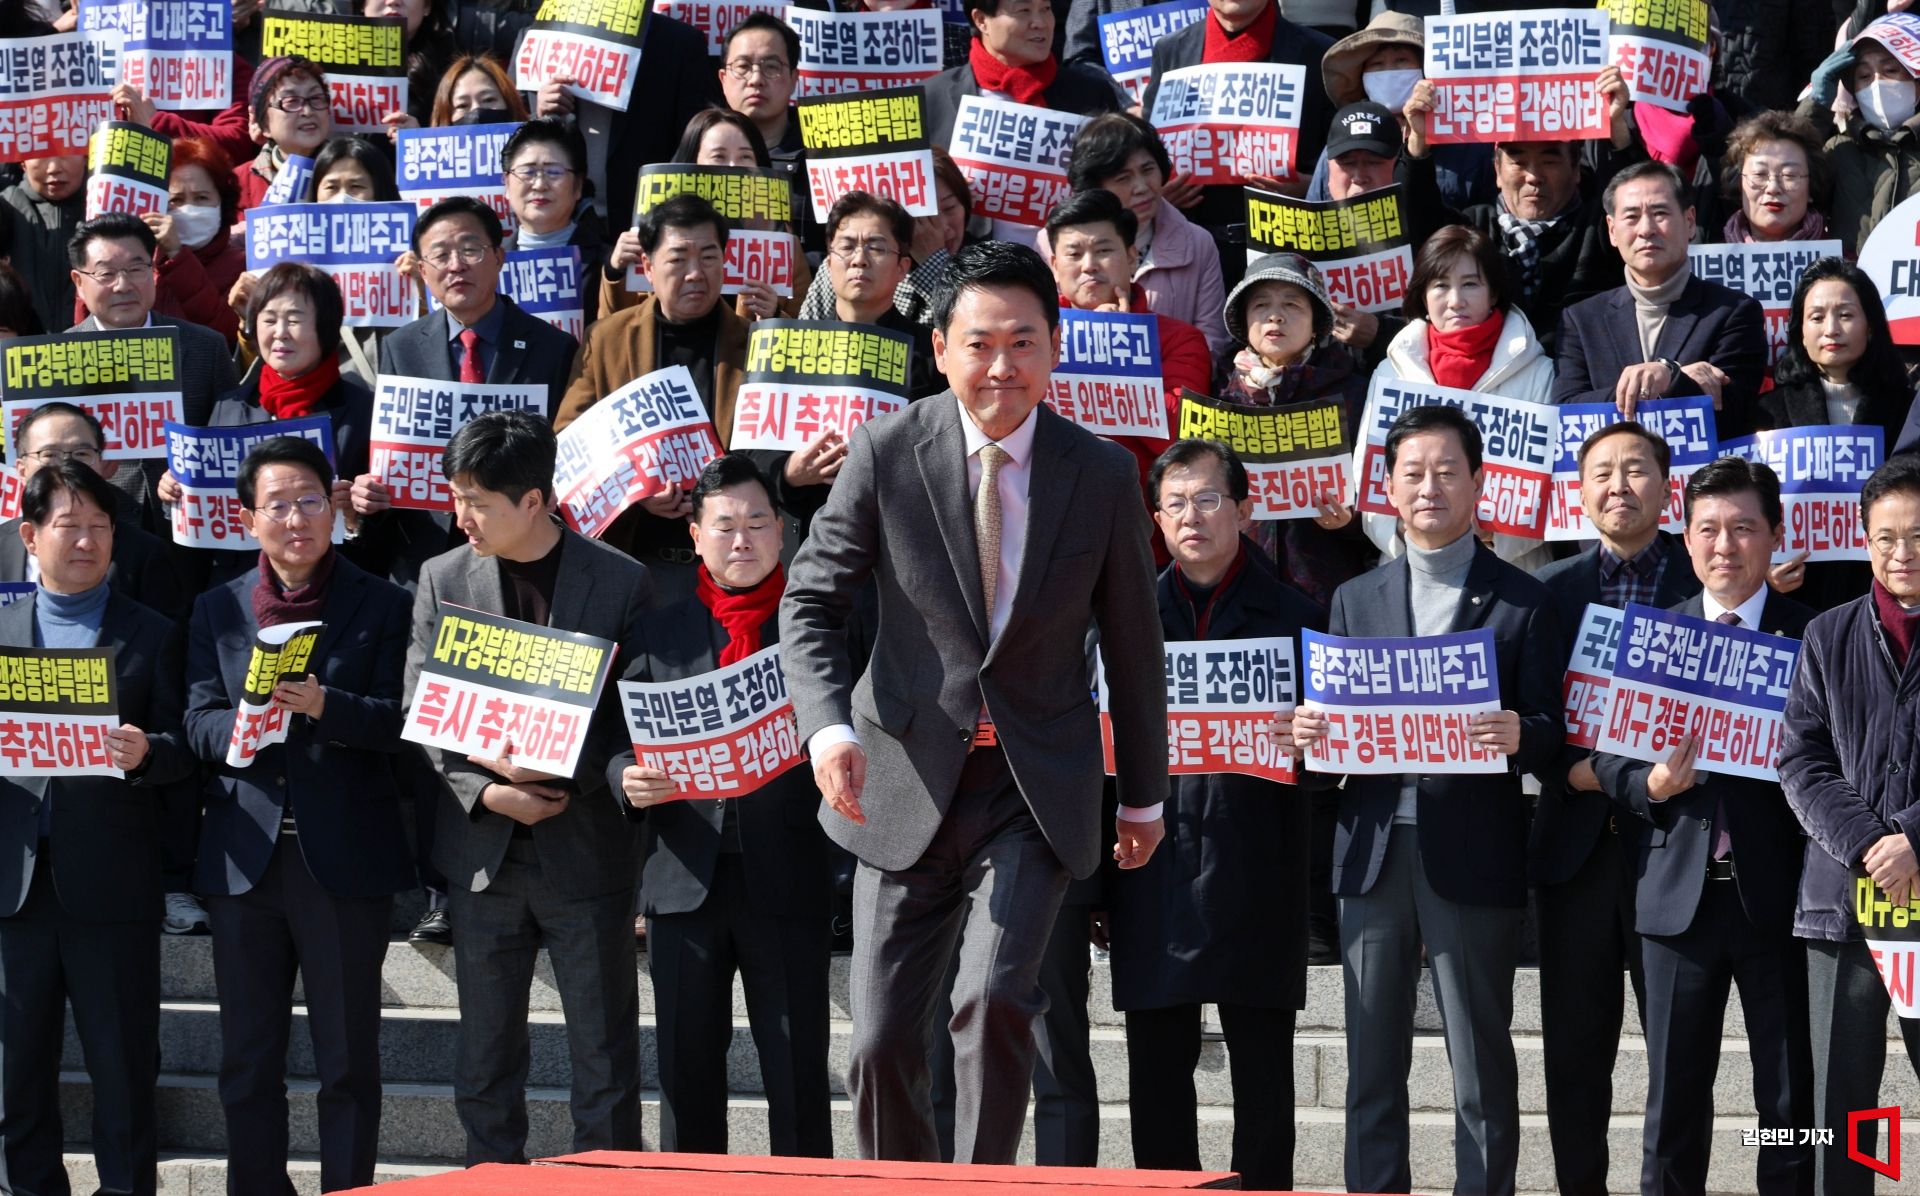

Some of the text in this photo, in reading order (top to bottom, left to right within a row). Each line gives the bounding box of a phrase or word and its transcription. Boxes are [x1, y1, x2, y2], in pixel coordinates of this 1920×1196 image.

[151, 2, 224, 41] 다퍼주고
[263, 17, 401, 66] 대구경북행정통합특별법
[863, 19, 937, 66] 조장하는
[1432, 19, 1603, 70] 국민분열 조장하는
[51, 41, 115, 88] 조장하는
[149, 57, 224, 100] 외면하나!
[519, 37, 548, 82] 즉시
[330, 82, 400, 126] 진하라
[1156, 74, 1217, 121] 국민분열
[1218, 73, 1295, 119] 조장하는
[1341, 112, 1381, 127] KOREA
[1434, 80, 1603, 136] 민주당은 각성하라
[403, 136, 471, 181] 광주전남
[959, 106, 1038, 162] 국민분열
[1216, 130, 1290, 178] 각성하라
[964, 166, 1026, 217] 주당은
[252, 212, 411, 259] 광주전남 다퍼주고
[1248, 195, 1402, 251] 대구경북행정통합특별법
[500, 257, 577, 304] 다퍼주고
[722, 238, 793, 287] 진하라
[1316, 255, 1408, 311] 진하라
[342, 270, 416, 317] 면하나!
[6, 337, 174, 389] 대구경북행정통합특별법
[748, 328, 908, 384] 대구경북행정통합특별법
[1073, 319, 1152, 367] 다퍼주고
[90, 400, 177, 451] 진하라
[378, 386, 454, 439] 국민분열
[611, 379, 699, 437] 조장하는
[738, 391, 788, 441] 즉시
[1080, 380, 1160, 428] 외면하나!
[168, 430, 240, 479] 광주전남
[1792, 436, 1875, 482] 다퍼주고
[1476, 471, 1541, 529] 성하라
[433, 614, 604, 695] 대구경북행정통합특별법
[1205, 647, 1293, 705] 조장하는
[1309, 641, 1489, 696] 광주전남 다퍼주고
[1627, 616, 1707, 682] 광주전남
[1703, 636, 1796, 700] 다퍼주고
[416, 681, 581, 767] 즉시 추진하라
[627, 681, 724, 739] 국민분열
[1608, 688, 1654, 748] 대구
[1651, 696, 1691, 754] 경북
[1353, 713, 1398, 764] 경북
